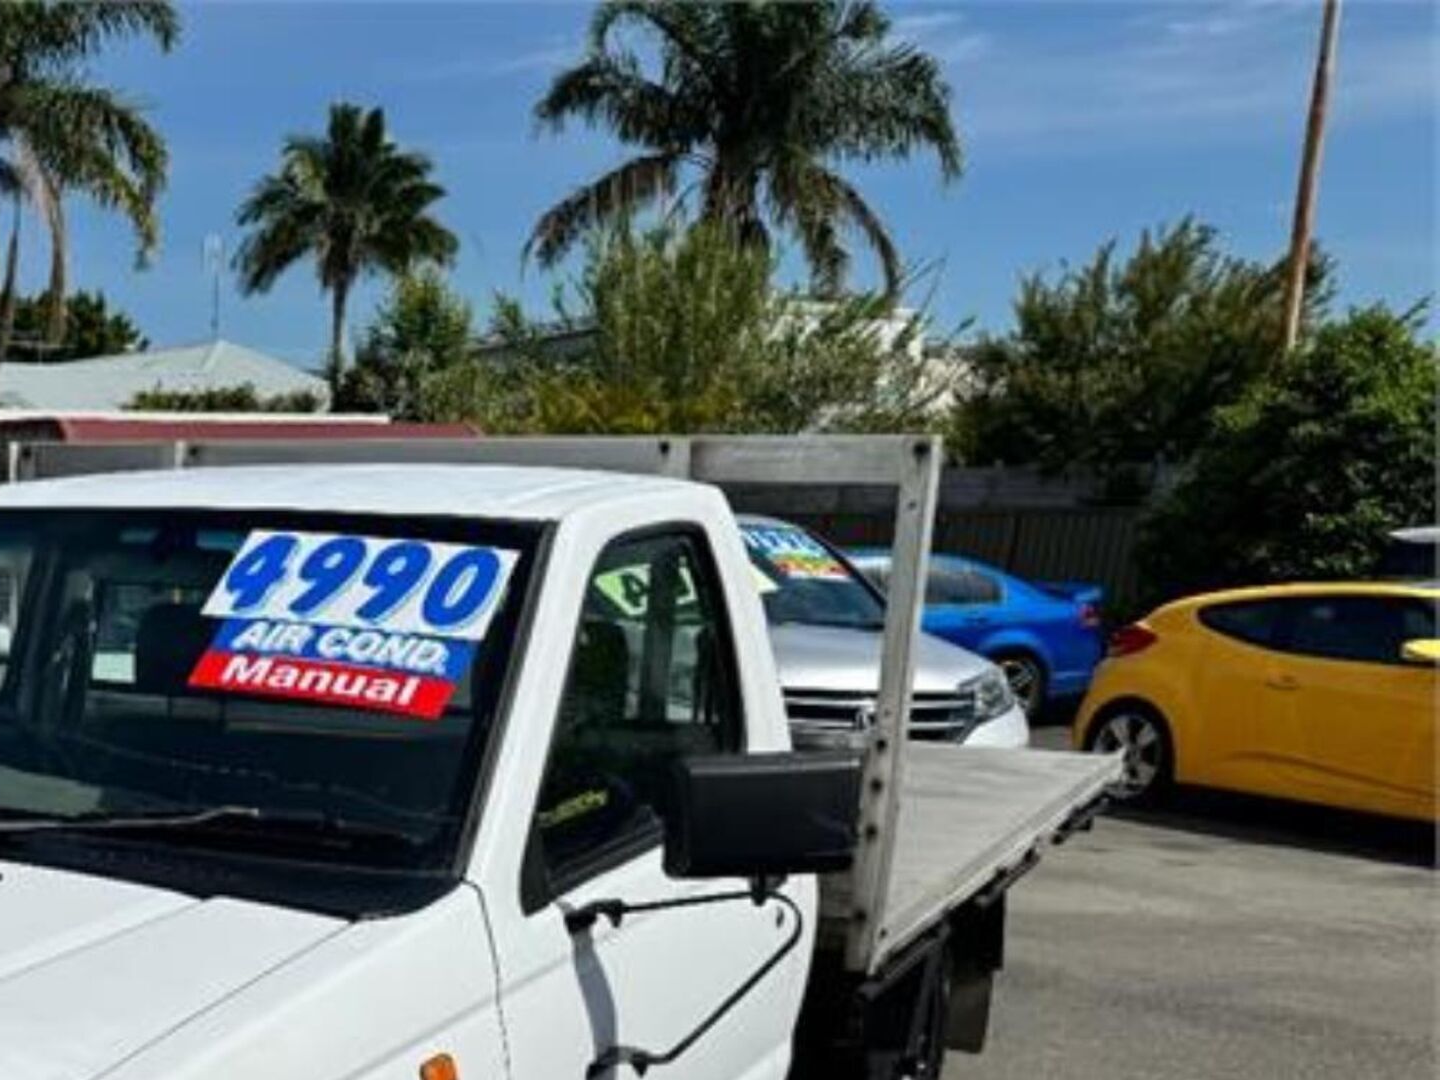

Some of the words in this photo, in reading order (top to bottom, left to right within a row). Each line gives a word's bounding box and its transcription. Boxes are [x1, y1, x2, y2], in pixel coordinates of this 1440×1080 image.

[224, 534, 501, 627] 4990
[231, 620, 314, 655] AIR
[221, 655, 421, 706] Manual
